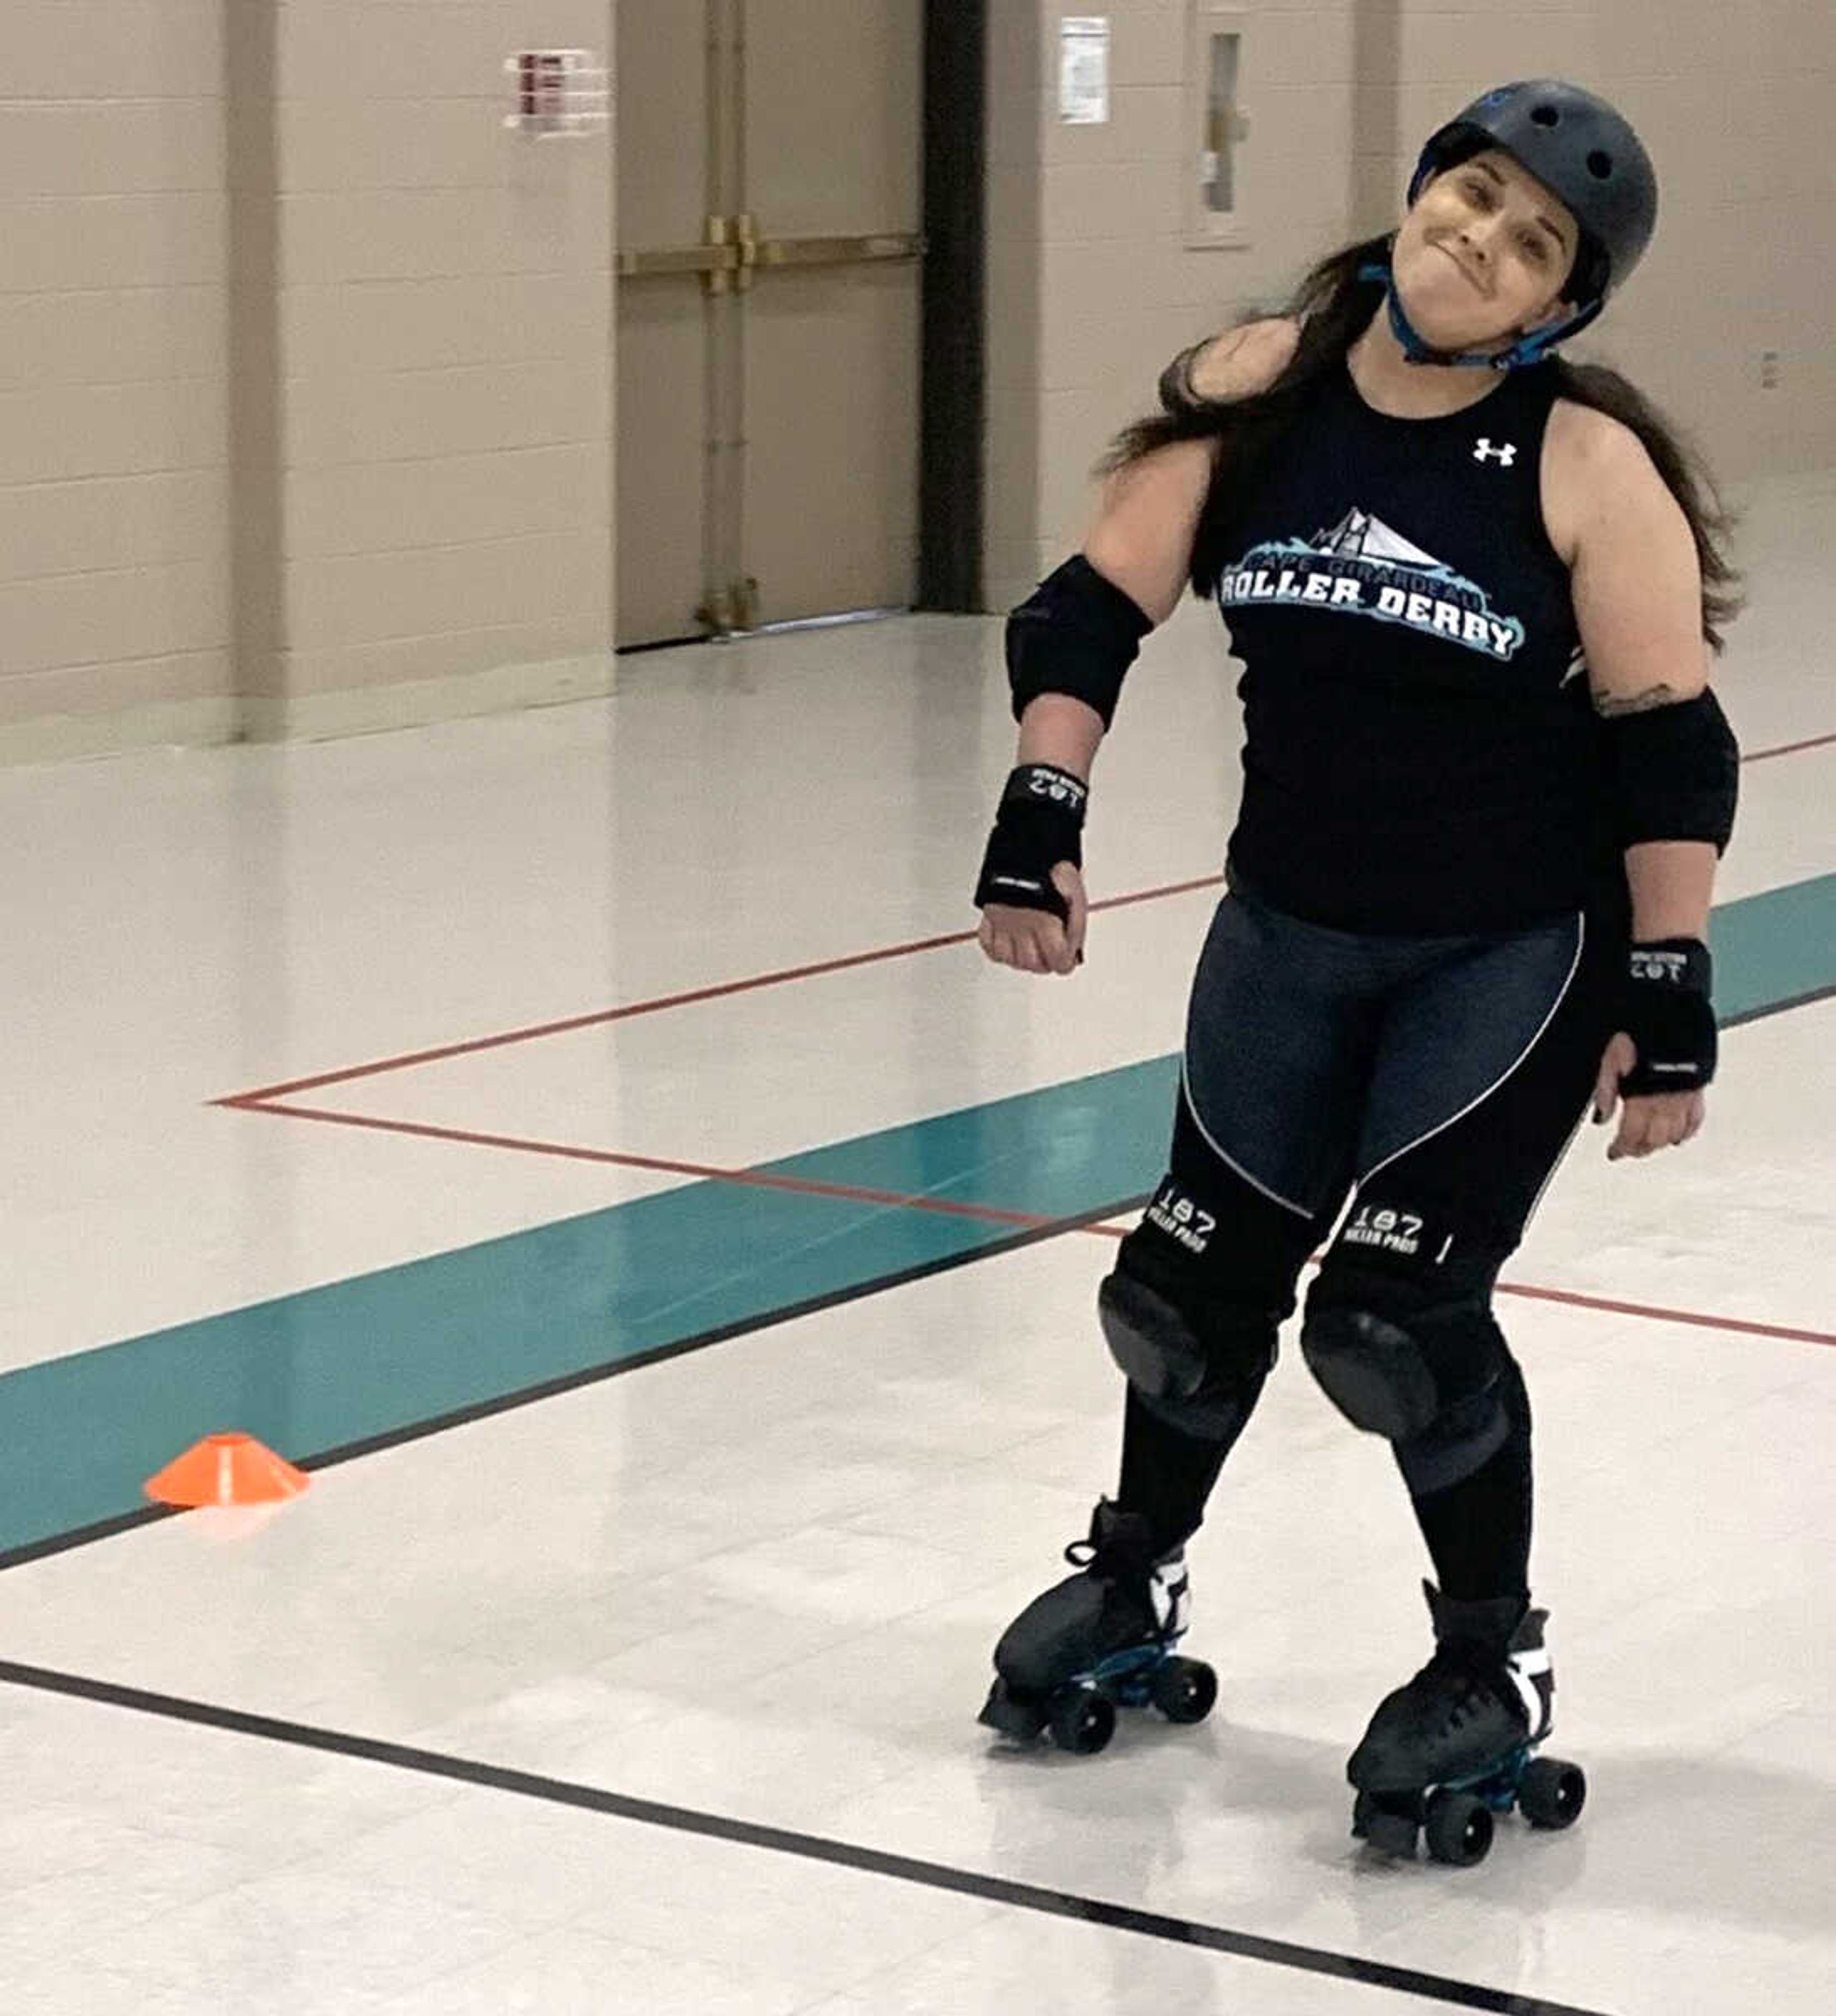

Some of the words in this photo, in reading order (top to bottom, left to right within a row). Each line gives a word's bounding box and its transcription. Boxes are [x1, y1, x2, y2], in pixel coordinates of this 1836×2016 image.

[1246, 552, 1312, 574] CAPE
[1221, 570, 1363, 604] ROLLER
[1377, 586, 1516, 656] DERBY
[1159, 1188, 1216, 1234] 187
[1354, 1205, 1423, 1236] 187
